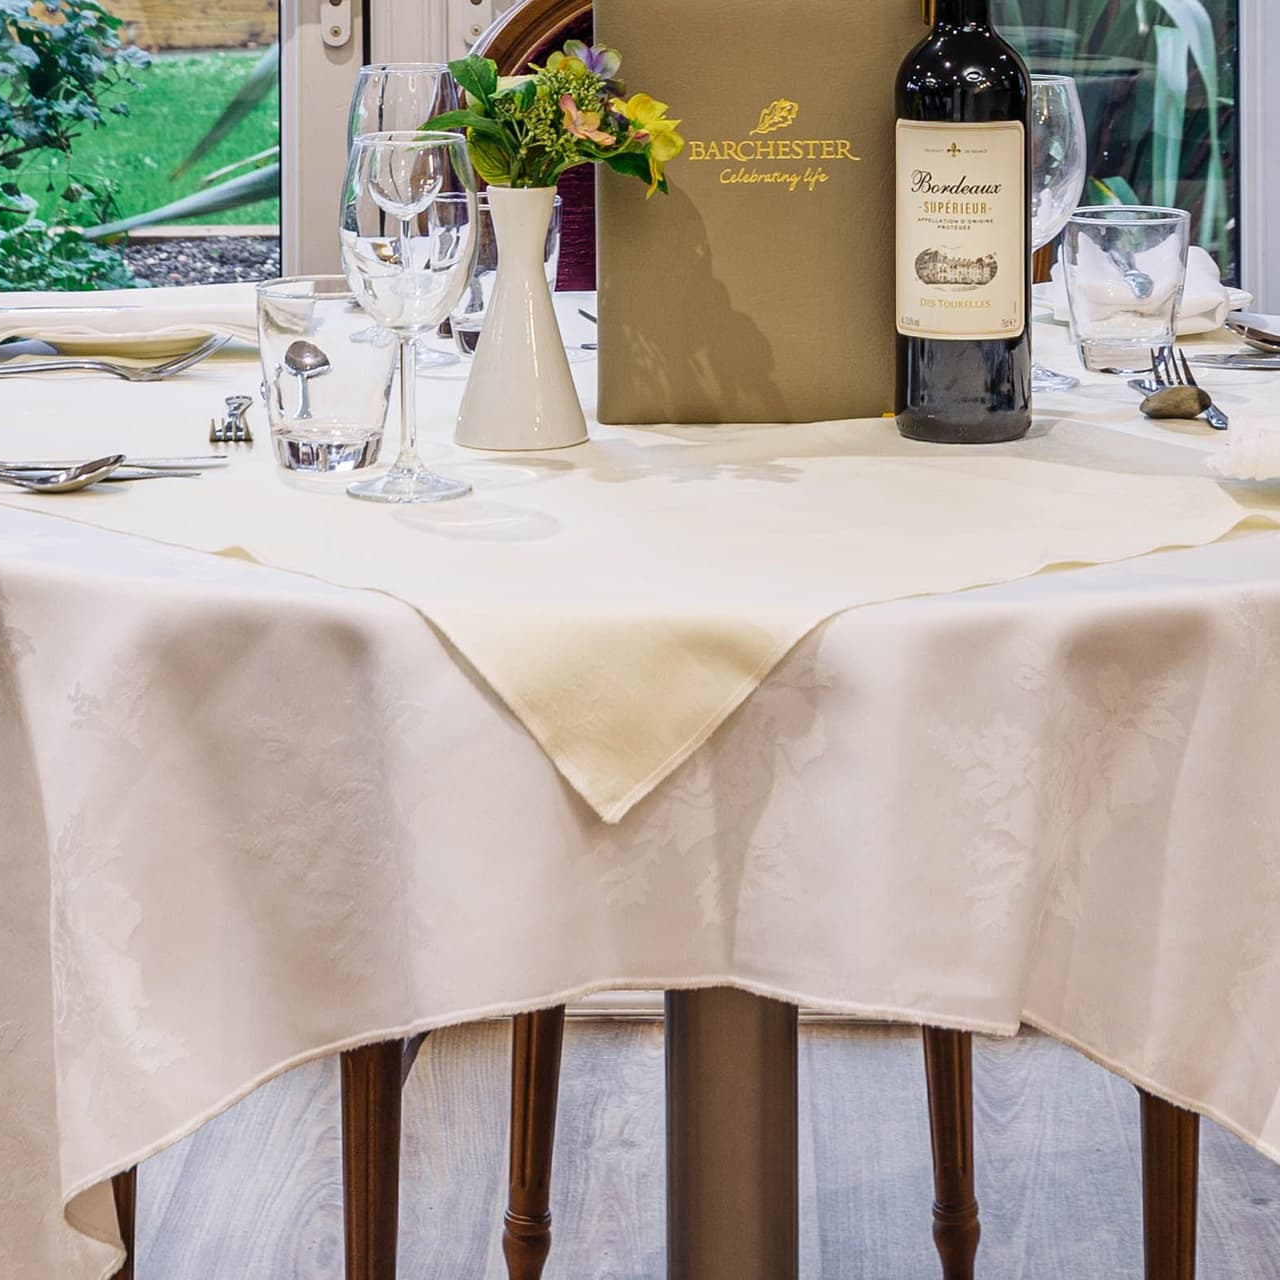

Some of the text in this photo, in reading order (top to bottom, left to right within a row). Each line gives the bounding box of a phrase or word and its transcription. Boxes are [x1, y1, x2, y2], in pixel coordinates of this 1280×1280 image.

[688, 139, 862, 162] BARCHESTER
[719, 167, 830, 192] Celebrating life
[910, 169, 1002, 195] Bordeaux
